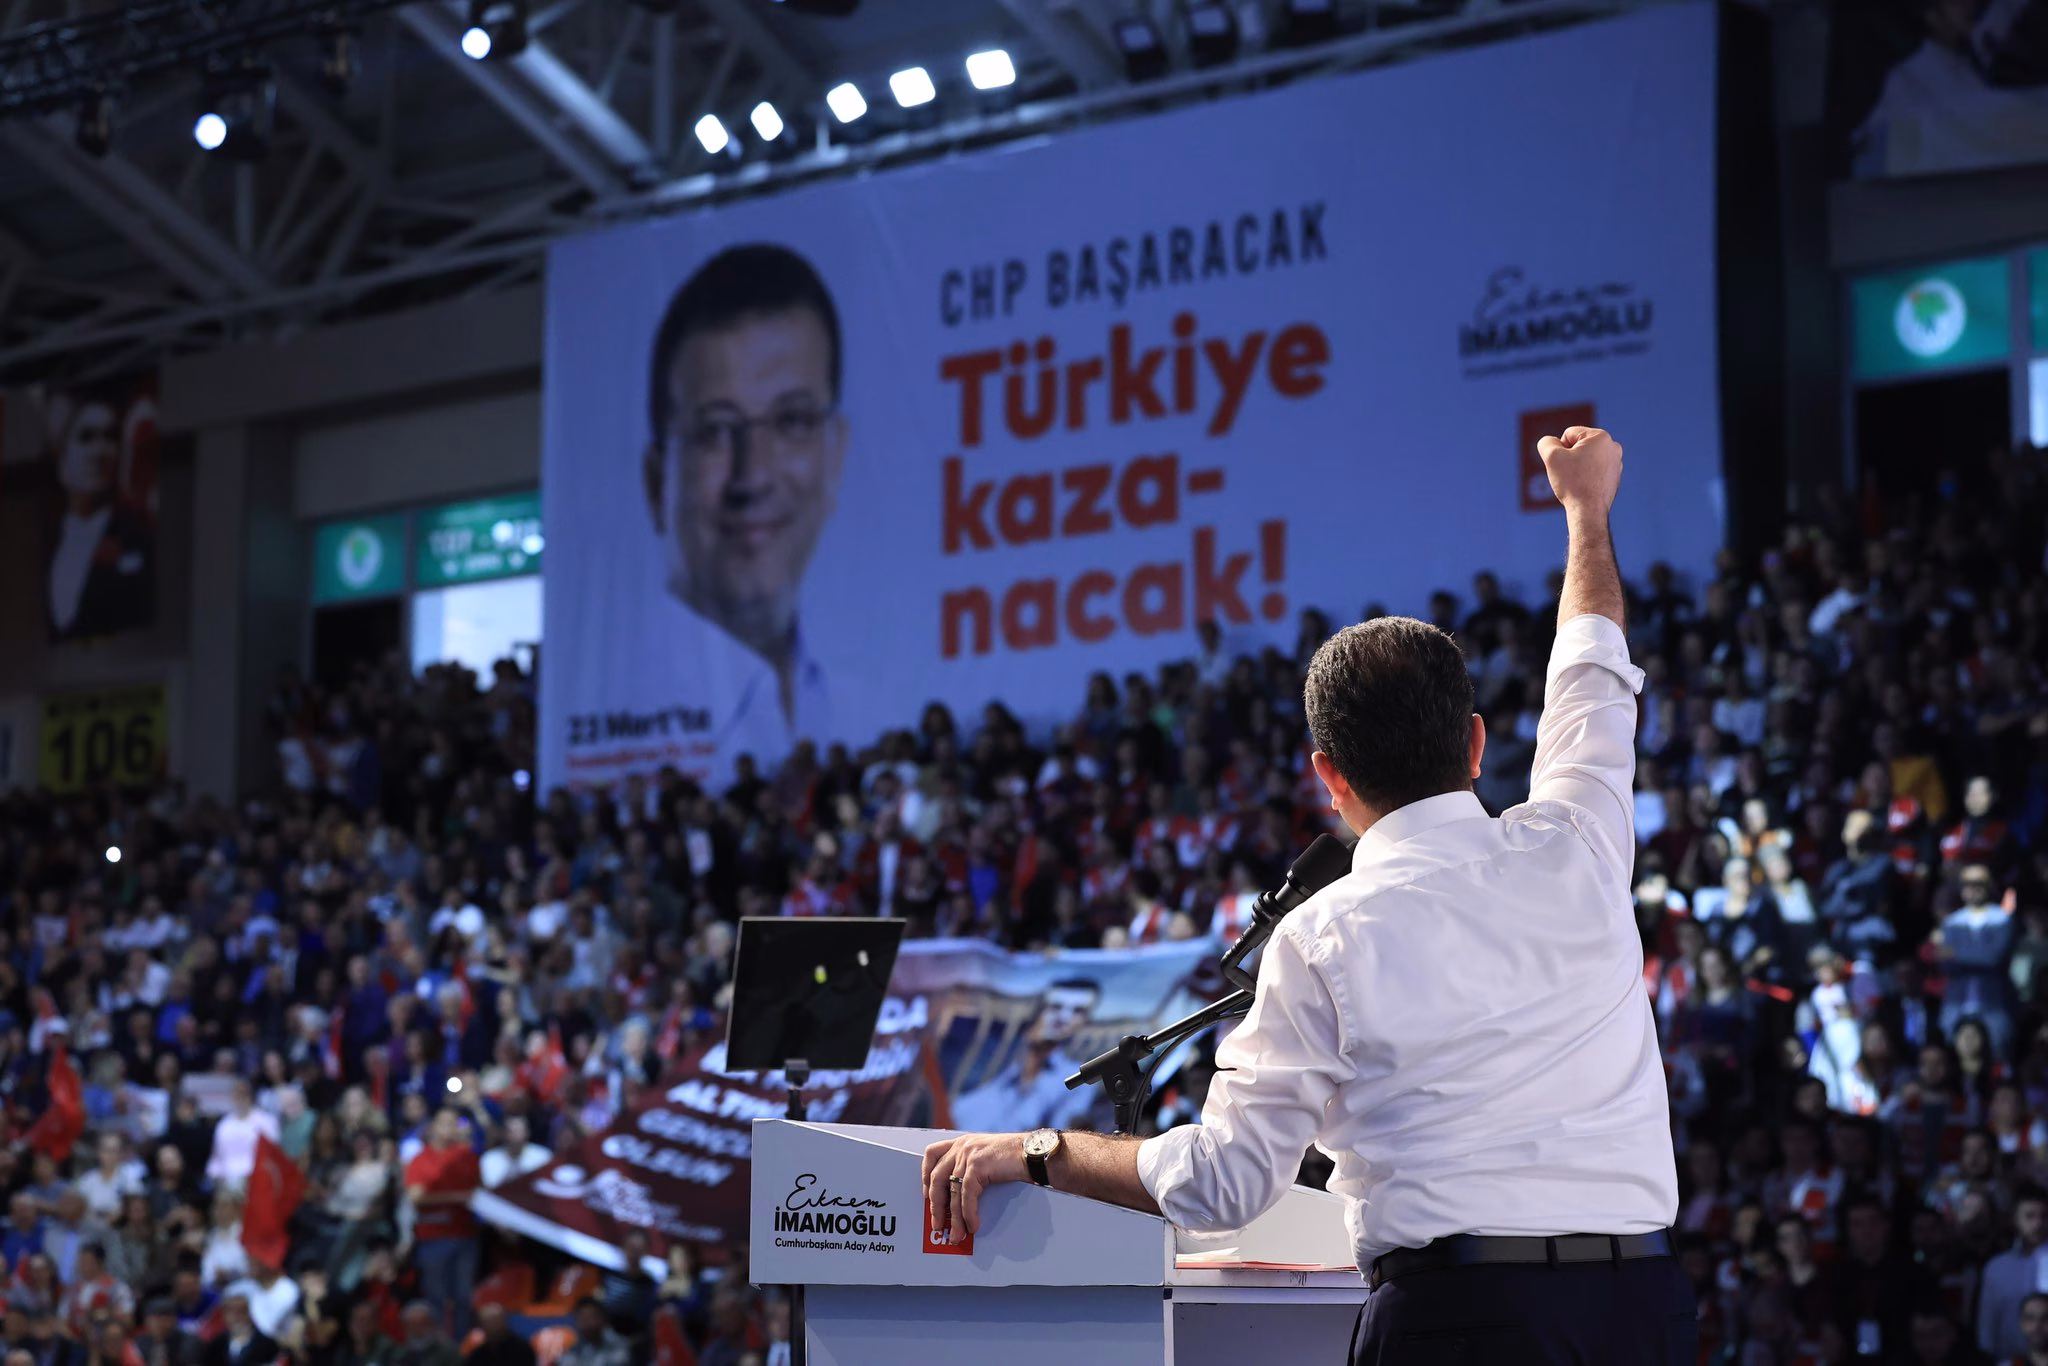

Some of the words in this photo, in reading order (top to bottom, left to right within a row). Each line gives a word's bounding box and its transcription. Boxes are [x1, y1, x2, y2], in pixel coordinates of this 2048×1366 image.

[940, 258, 1027, 328] CHP
[1046, 201, 1328, 308] BAŞARACAK
[939, 311, 1331, 449] Türkiye
[940, 453, 1226, 556] kaza-
[940, 518, 1289, 659] nacak!
[49, 714, 154, 785] 106
[774, 1206, 896, 1237] İMAMOĞLU
[775, 1237, 843, 1251] Cumhurbaşkanı
[844, 1240, 867, 1253] Aday
[868, 1242, 895, 1254] Adayı
